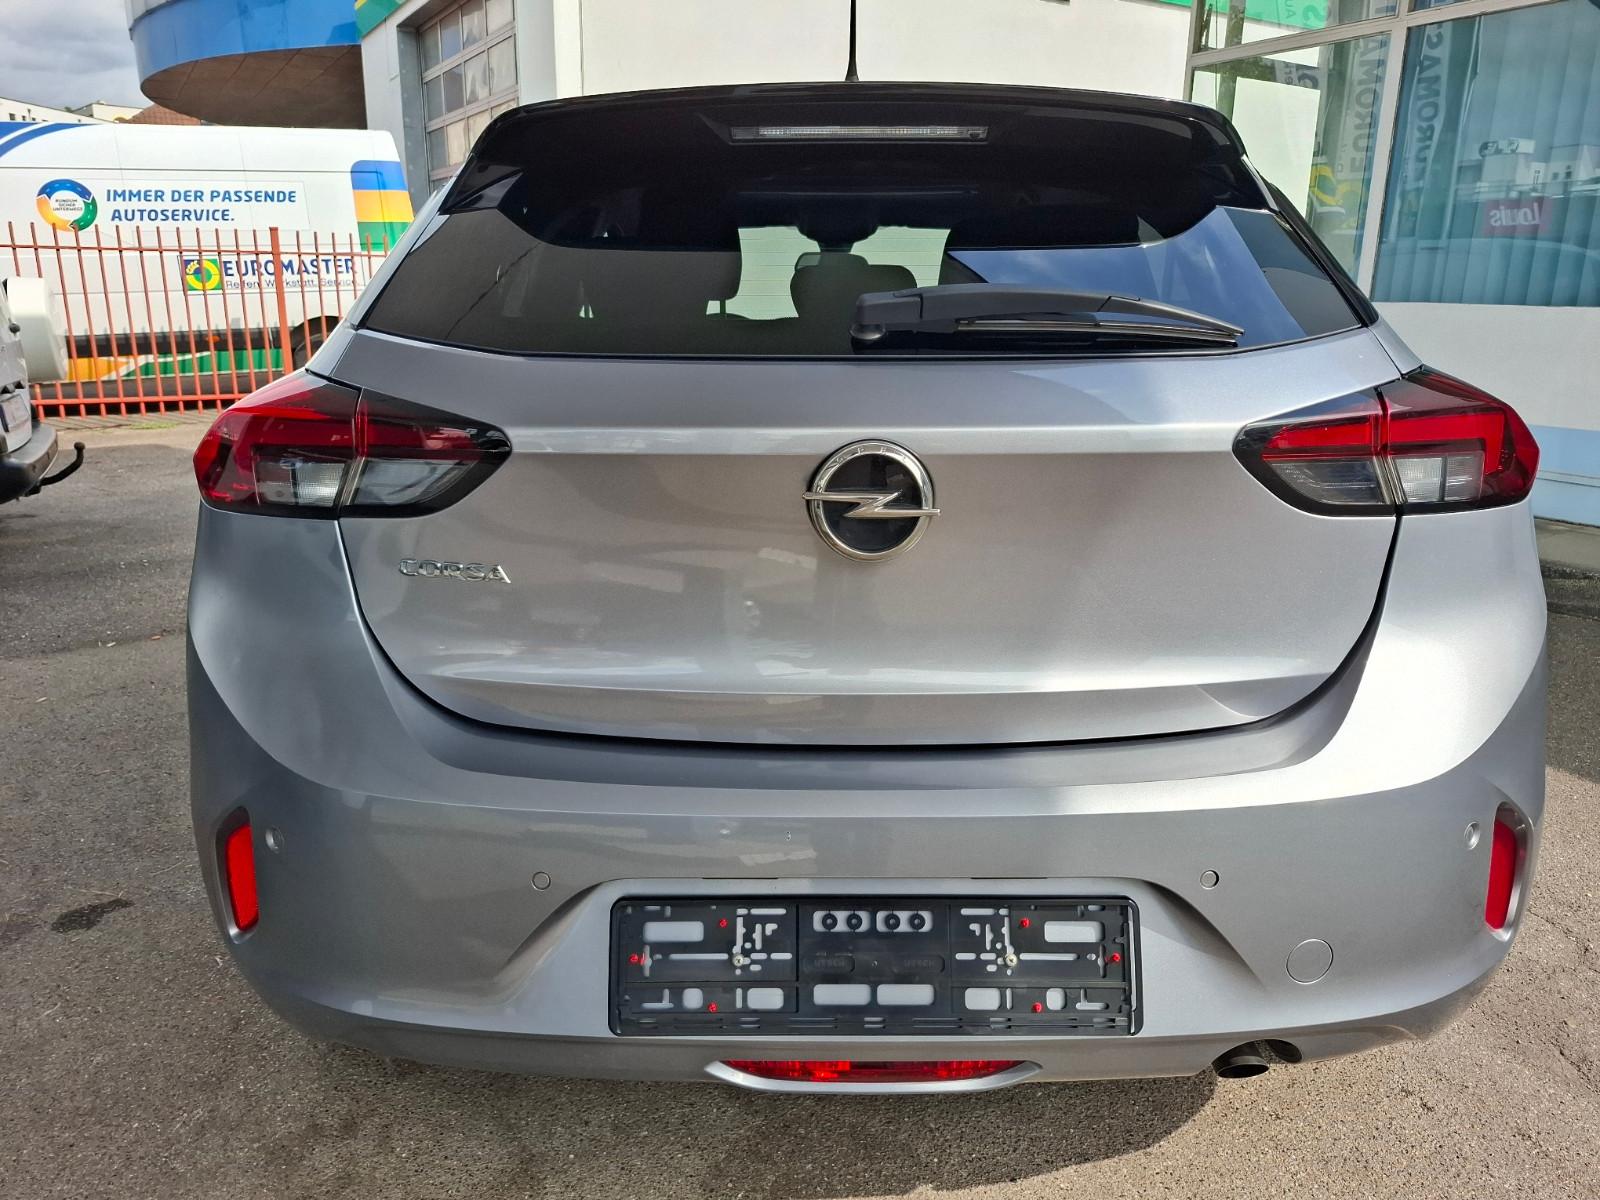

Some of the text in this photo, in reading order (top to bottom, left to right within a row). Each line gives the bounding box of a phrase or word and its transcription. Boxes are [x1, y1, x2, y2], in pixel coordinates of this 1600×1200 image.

[106, 189, 297, 203] IMMER DER PASSENDE
[111, 208, 235, 222] AUTOSERVICE.
[223, 257, 357, 277] EUROMASTER
[399, 558, 512, 584] CORSA
